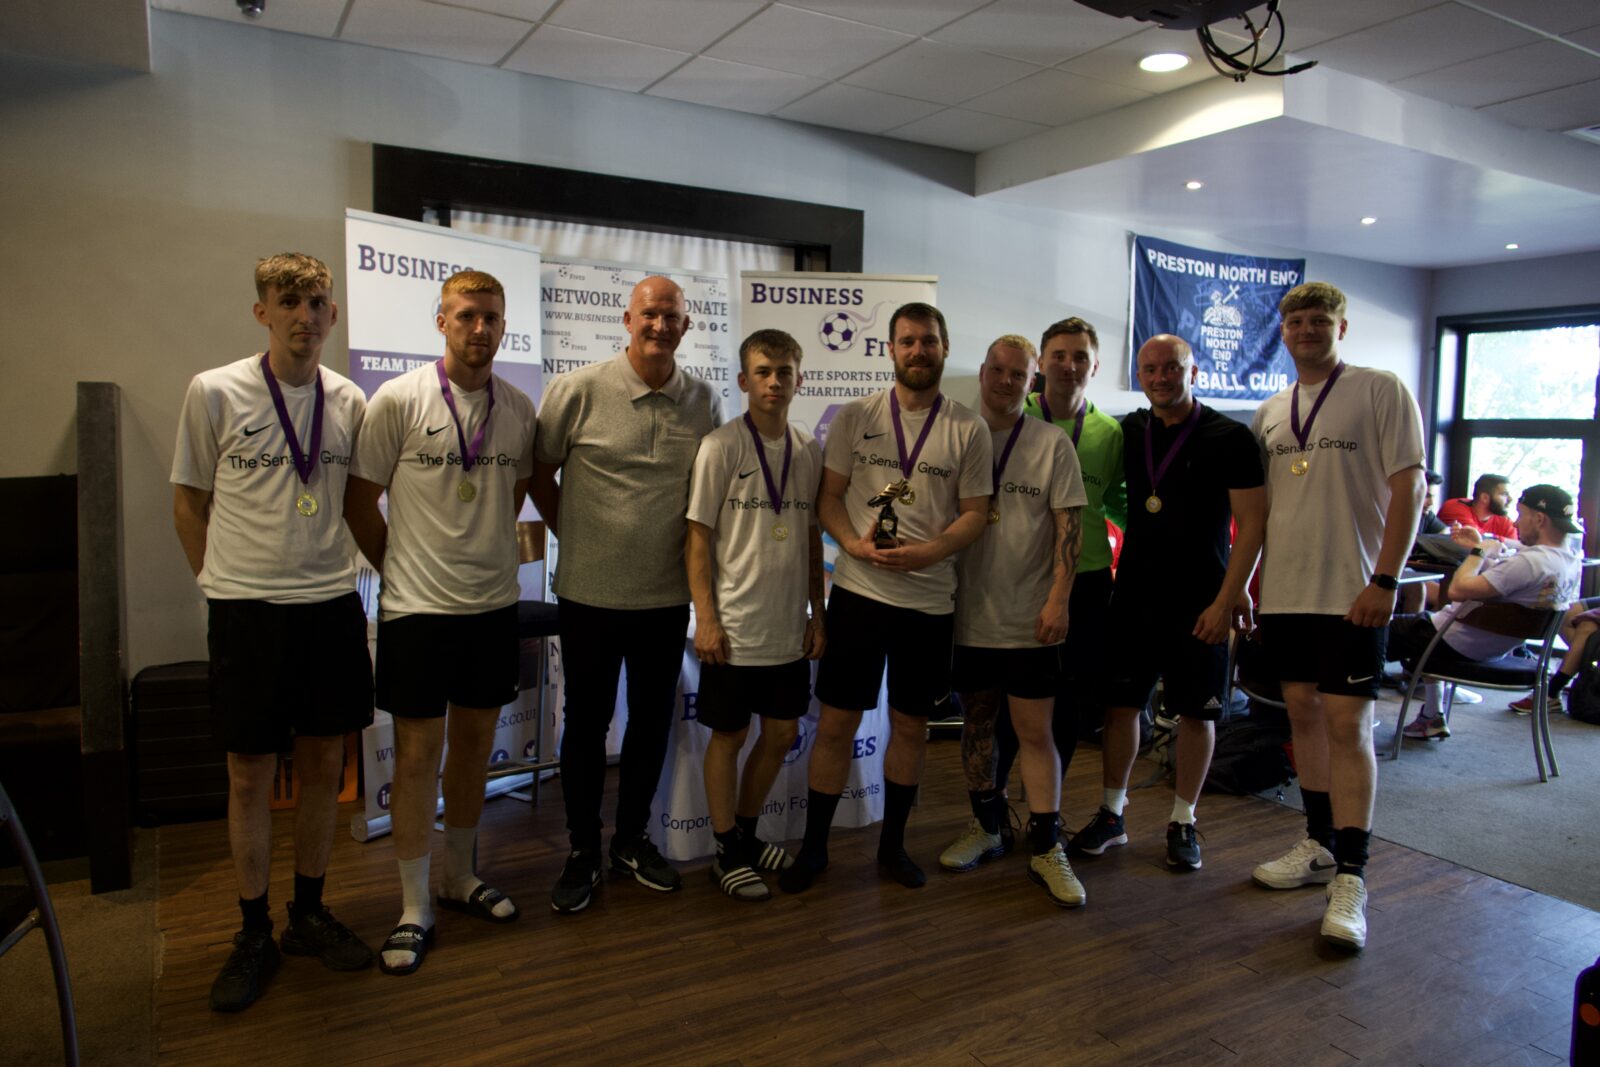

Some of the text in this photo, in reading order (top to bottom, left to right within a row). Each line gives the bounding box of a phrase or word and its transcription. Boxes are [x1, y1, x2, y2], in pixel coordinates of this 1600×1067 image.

[358, 244, 475, 282] BUSINE
[1147, 249, 1298, 286] PRESTON NORTH END
[541, 287, 729, 316] NETWORK. ONATE
[751, 283, 863, 306] BUSINESS
[1201, 325, 1243, 340] PRESTON
[500, 332, 531, 352] VES
[1206, 338, 1238, 351] NORTH
[360, 355, 404, 372] TEAM
[1213, 350, 1232, 361] END
[683, 365, 729, 381] ONATE
[1216, 361, 1228, 372] FC
[826, 371, 872, 381] SPORTS
[1197, 371, 1288, 391] BALL CLUB
[1319, 437, 1357, 452] Group
[228, 455, 257, 469] The
[417, 453, 443, 465] The
[446, 453, 495, 465] Setor
[918, 461, 951, 479] Group
[1004, 481, 1041, 498] Group
[728, 498, 750, 510] The
[661, 813, 711, 833] Corpor
